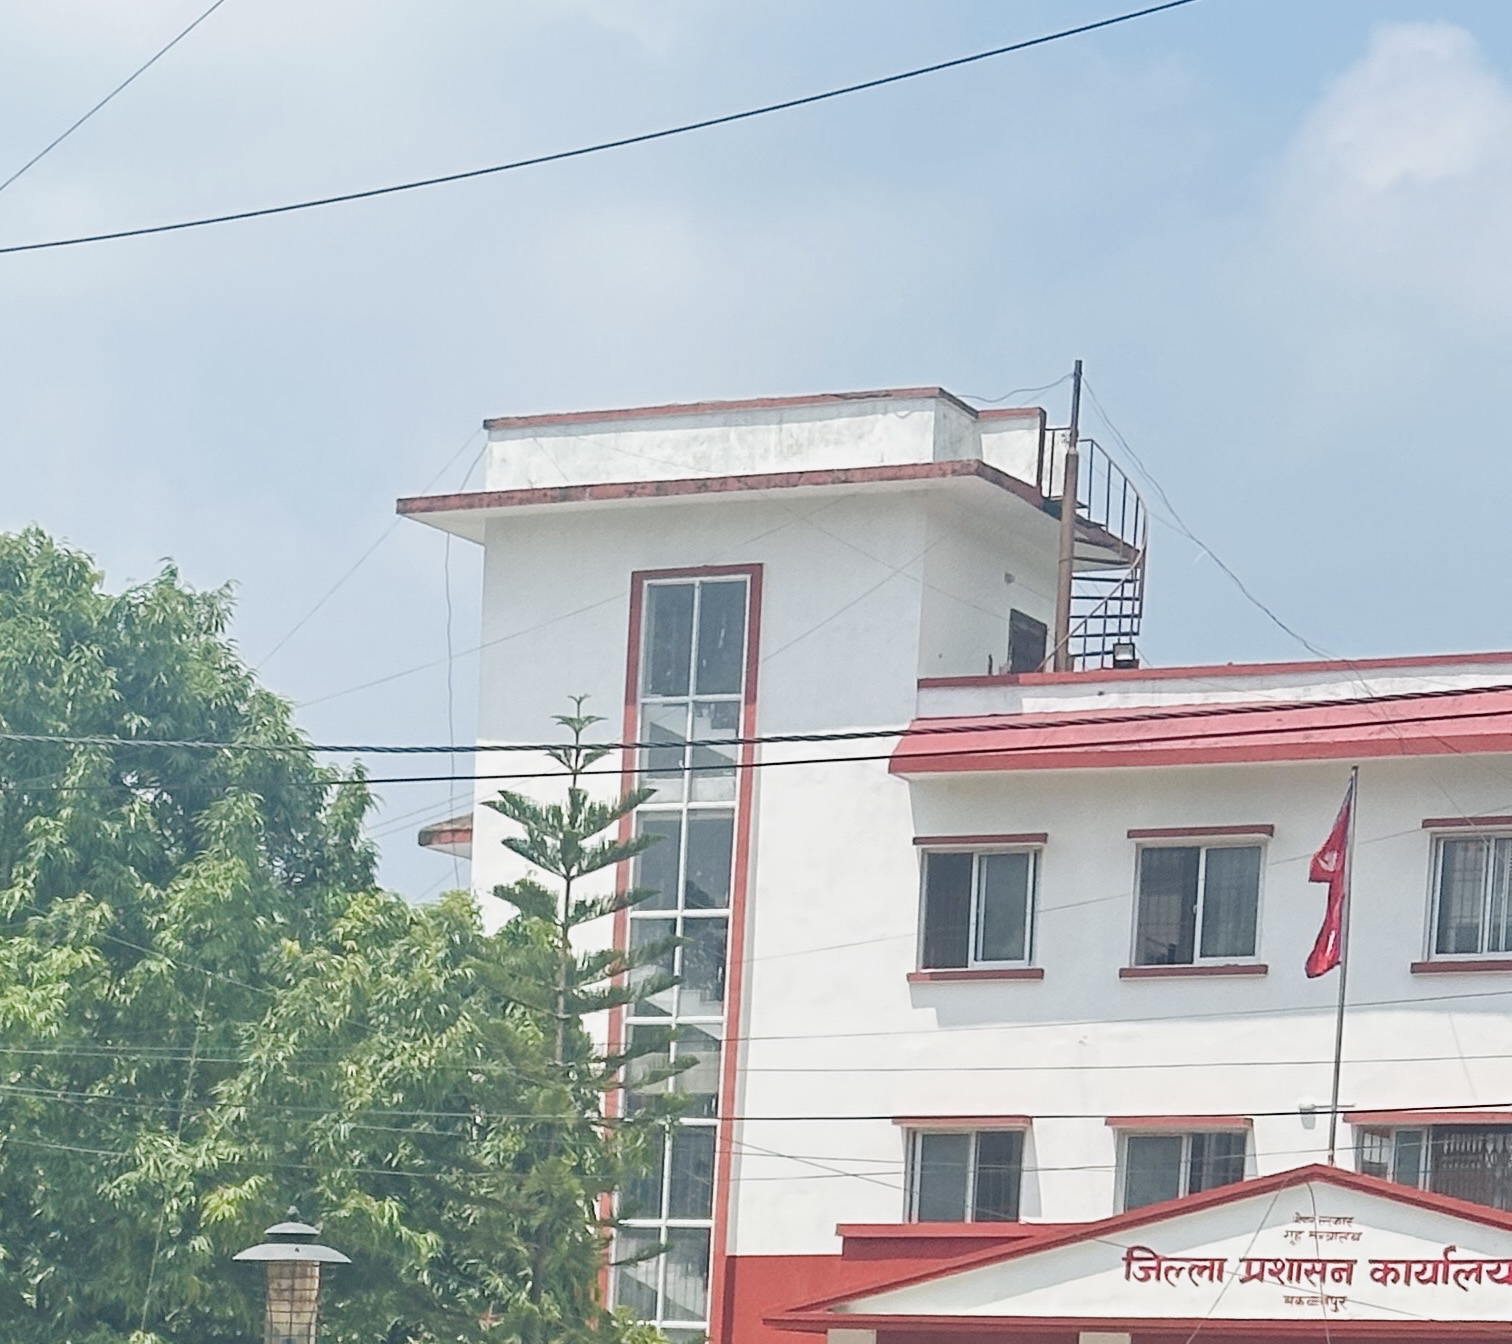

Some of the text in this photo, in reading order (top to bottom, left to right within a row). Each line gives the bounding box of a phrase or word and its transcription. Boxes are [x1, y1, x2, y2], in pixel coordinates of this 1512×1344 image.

[1122, 1245, 1512, 1291] जिल्ला प्रशासन कार्यालय
